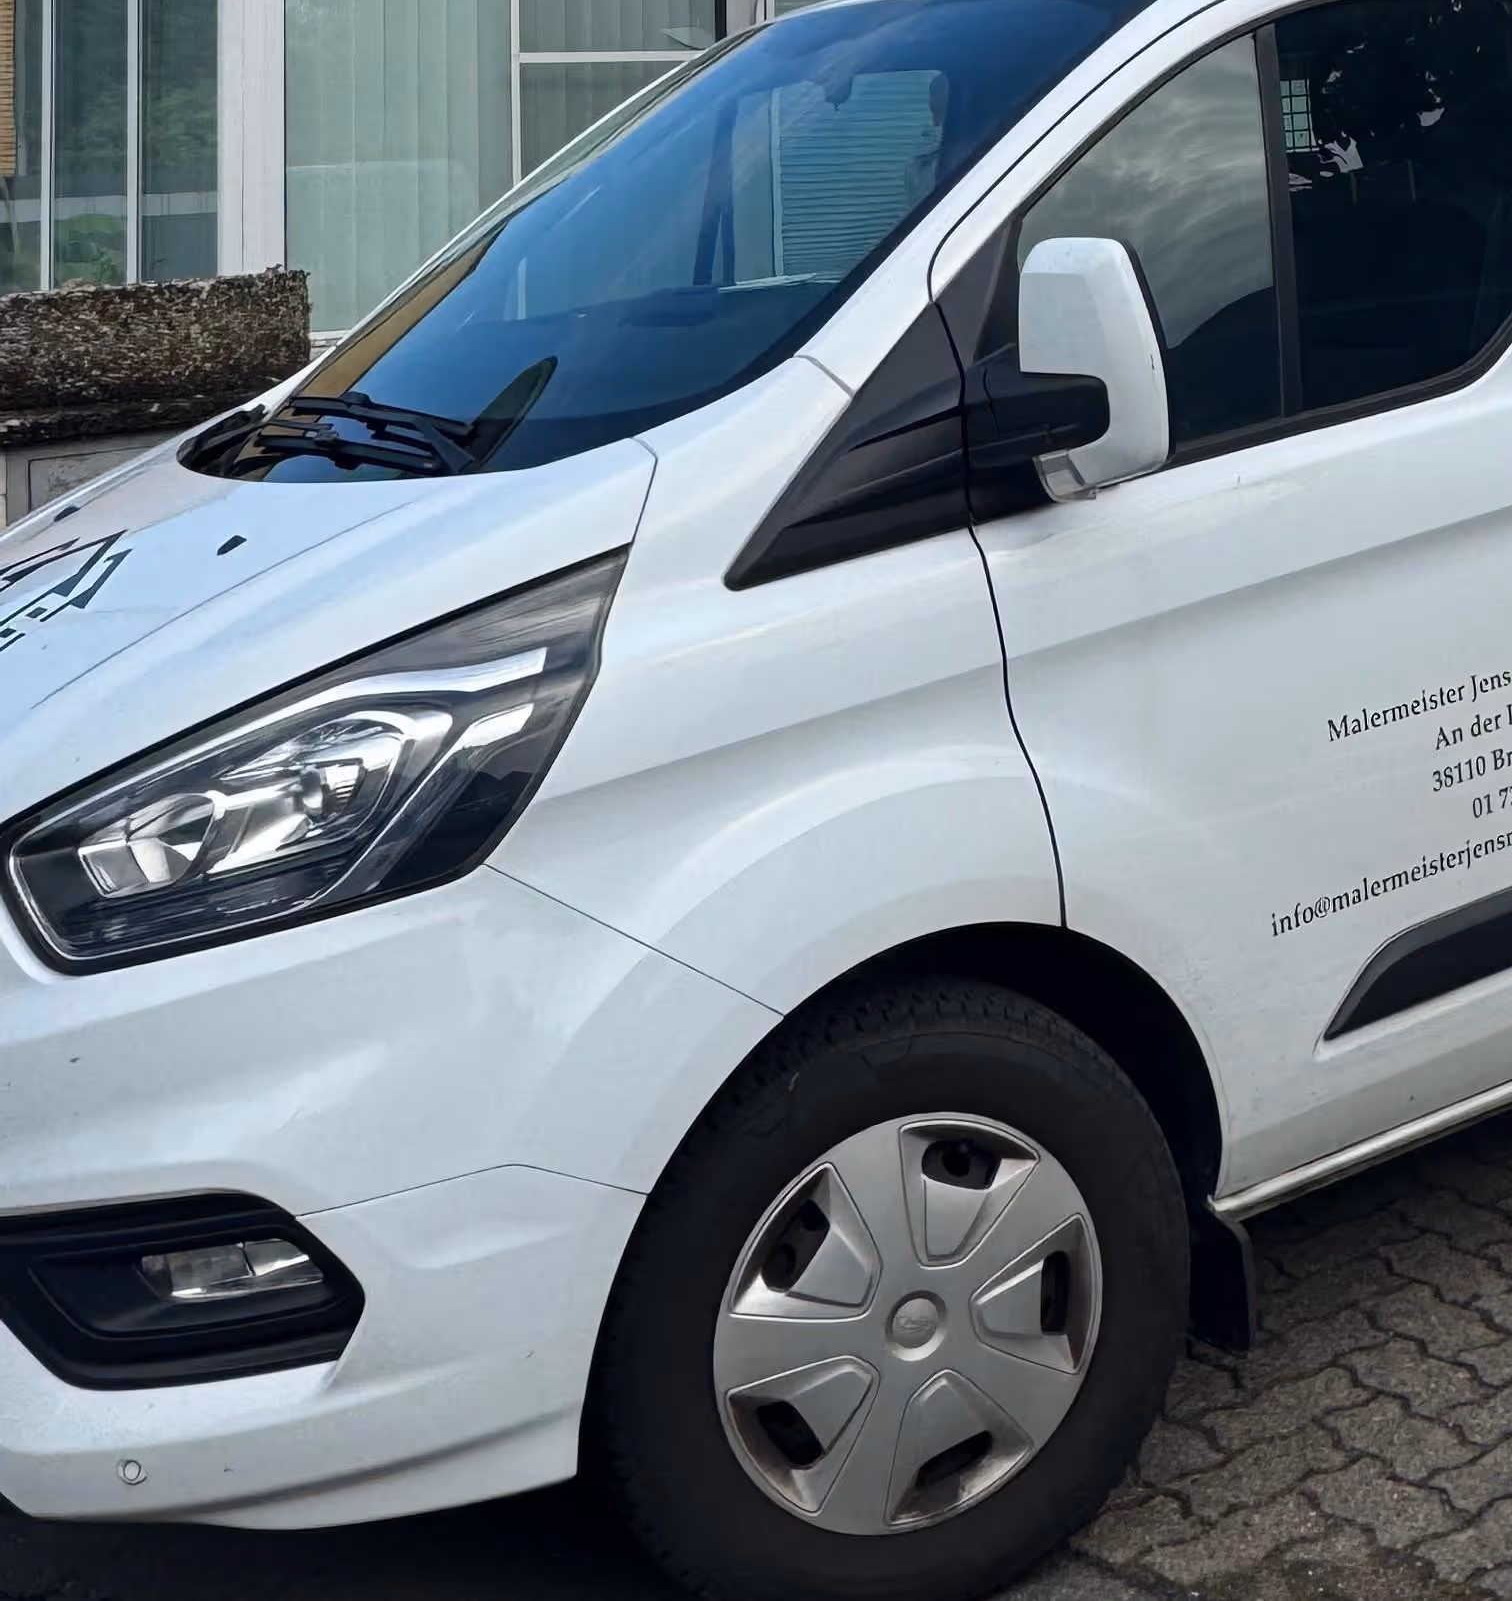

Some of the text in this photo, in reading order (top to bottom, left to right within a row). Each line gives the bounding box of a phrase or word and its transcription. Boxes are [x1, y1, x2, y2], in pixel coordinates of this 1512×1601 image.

[1327, 684, 1465, 742] Malermeister
[1470, 669, 1512, 701] Jens
[1435, 726, 1464, 750] An
[1470, 713, 1502, 738] der
[1432, 755, 1486, 792] 38110
[1472, 794, 1494, 819] 01
